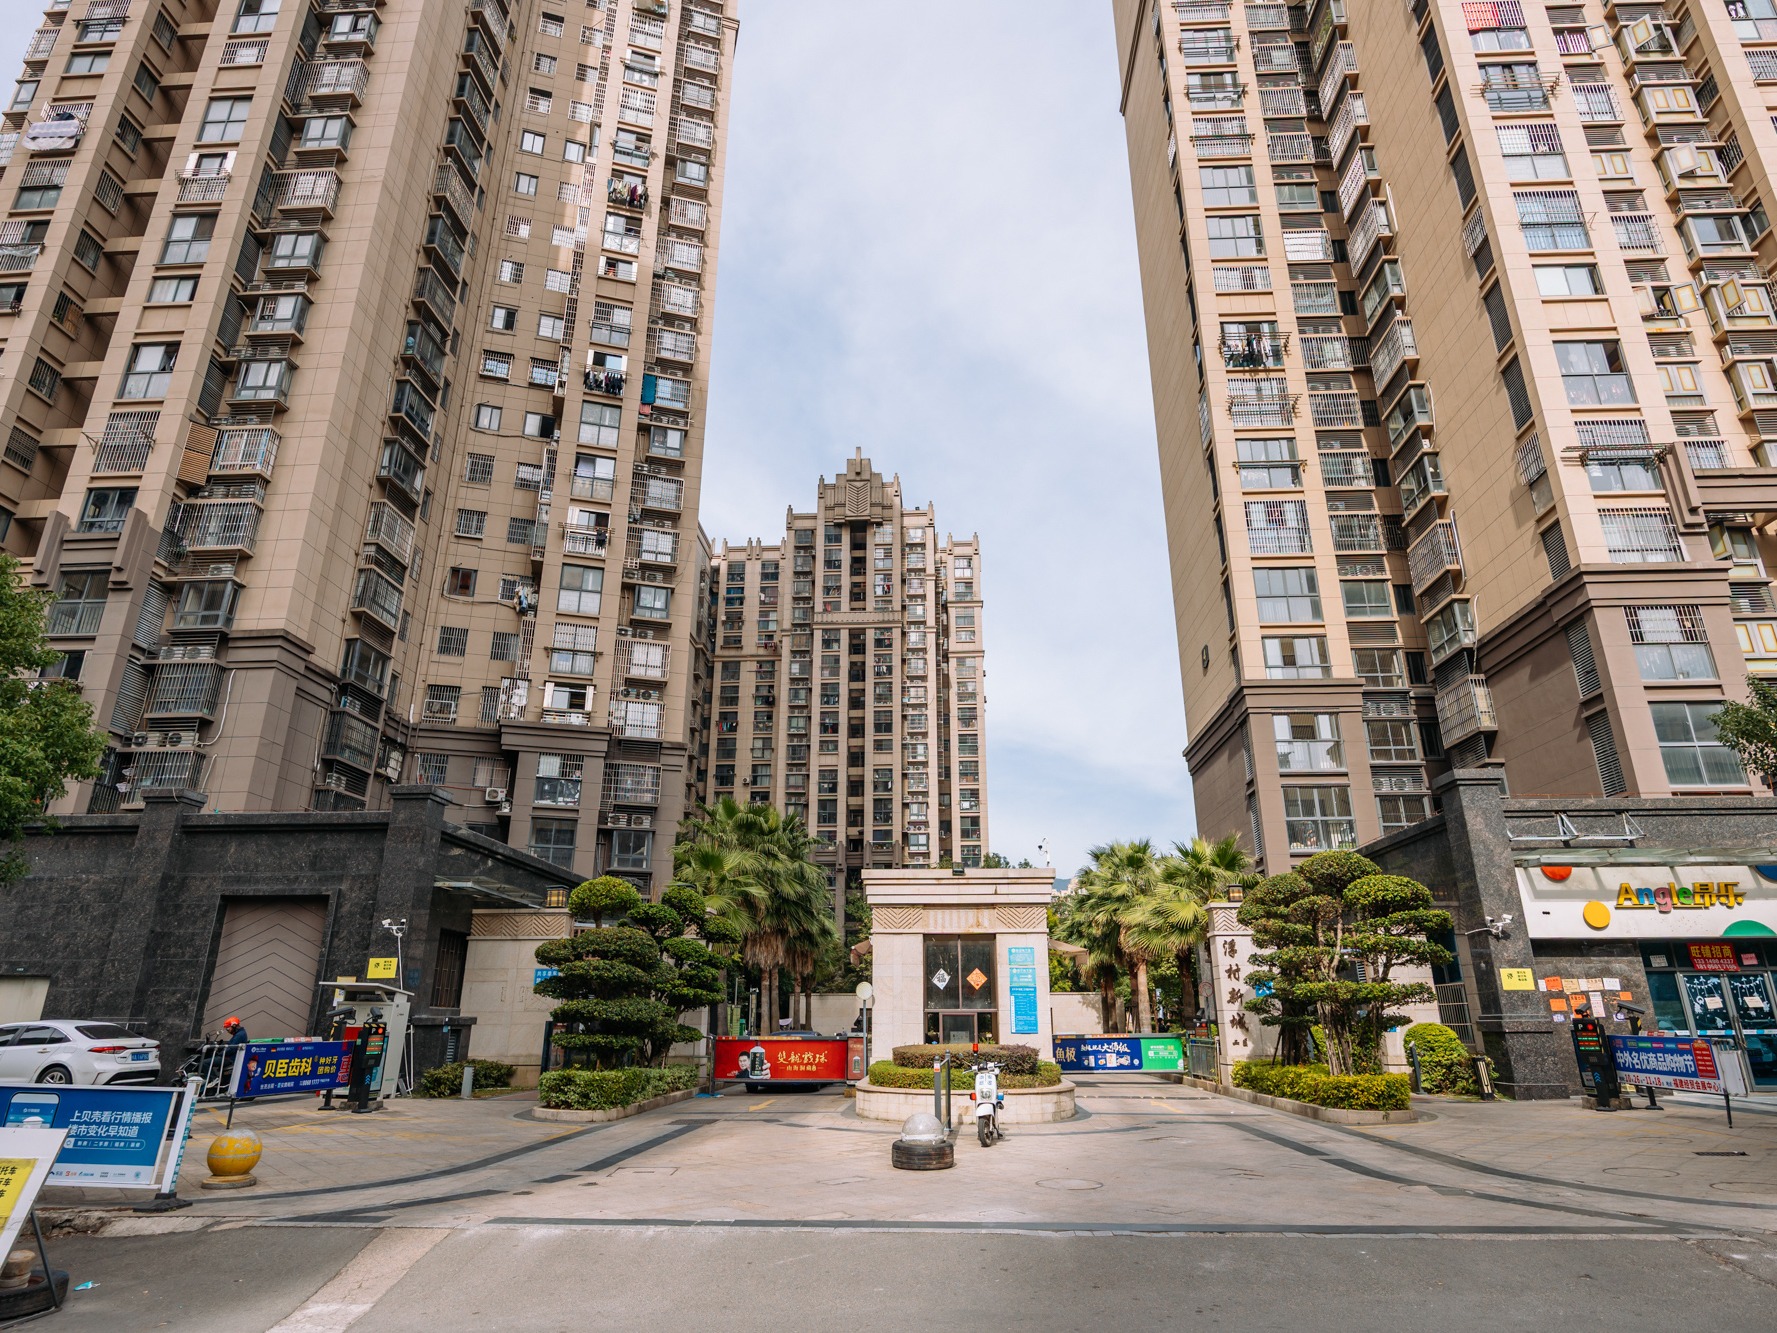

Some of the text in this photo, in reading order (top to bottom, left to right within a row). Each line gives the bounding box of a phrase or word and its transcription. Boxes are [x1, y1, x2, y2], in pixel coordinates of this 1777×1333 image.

[262, 1057, 312, 1078] 贝臣齿科
[1616, 1050, 1695, 1073] 中外名优商品购物节
[70, 1110, 152, 1124] 上贝壳看行情播报
[68, 1124, 139, 1137] 楼市变化早知道
[0, 1166, 17, 1175] 托车
